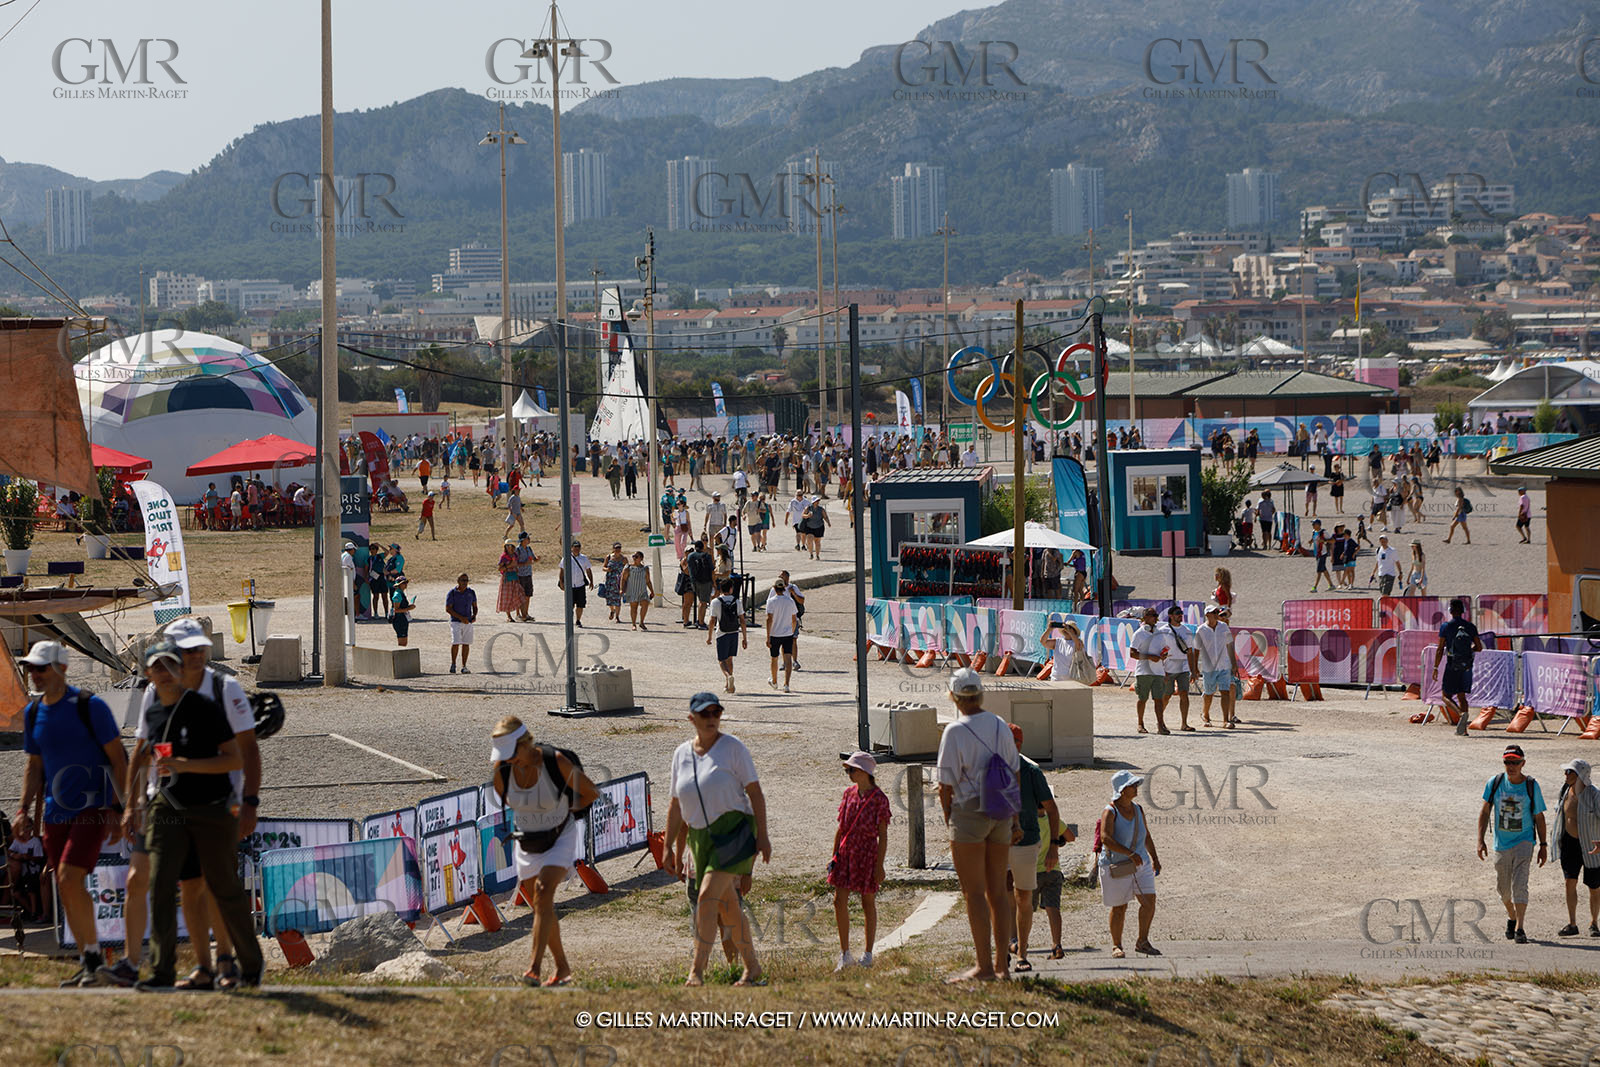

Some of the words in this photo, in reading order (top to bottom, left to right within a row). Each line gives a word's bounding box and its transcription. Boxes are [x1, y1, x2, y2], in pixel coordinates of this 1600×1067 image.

[341, 493, 361, 504] RIS
[341, 504, 361, 514] 24
[1306, 608, 1352, 623] PARIS
[1010, 619, 1035, 637] PARIS
[1538, 665, 1571, 684] PARIS
